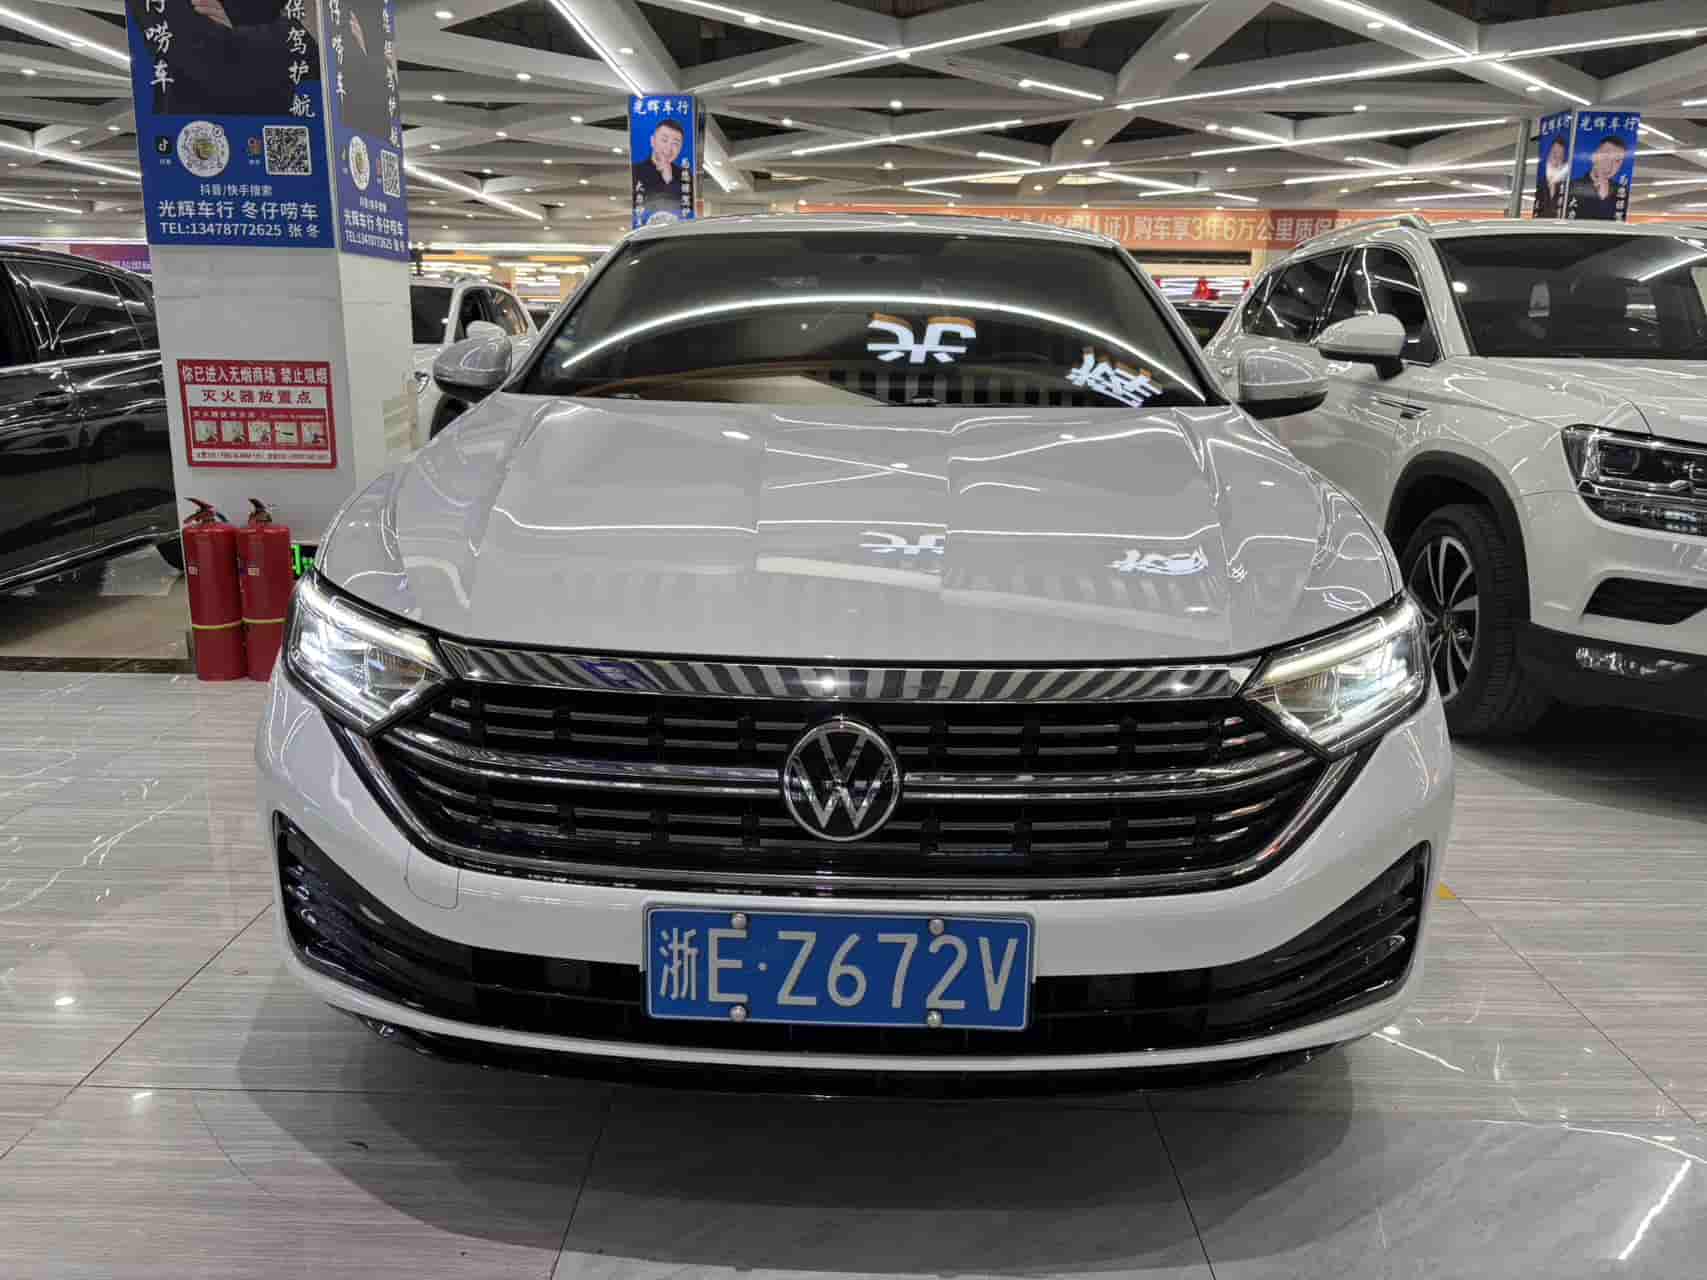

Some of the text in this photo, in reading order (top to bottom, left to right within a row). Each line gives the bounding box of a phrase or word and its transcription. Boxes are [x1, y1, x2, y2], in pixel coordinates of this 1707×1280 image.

[632, 99, 689, 115] 光辉车行
[158, 200, 319, 220] 光辉车行 冬仔唠车
[160, 222, 282, 236] TEL:13478772625
[280, 367, 328, 384] 禁止吸烟
[201, 389, 312, 404] 灭火器放置点
[659, 927, 1019, 1012] 浙E·Z672V
